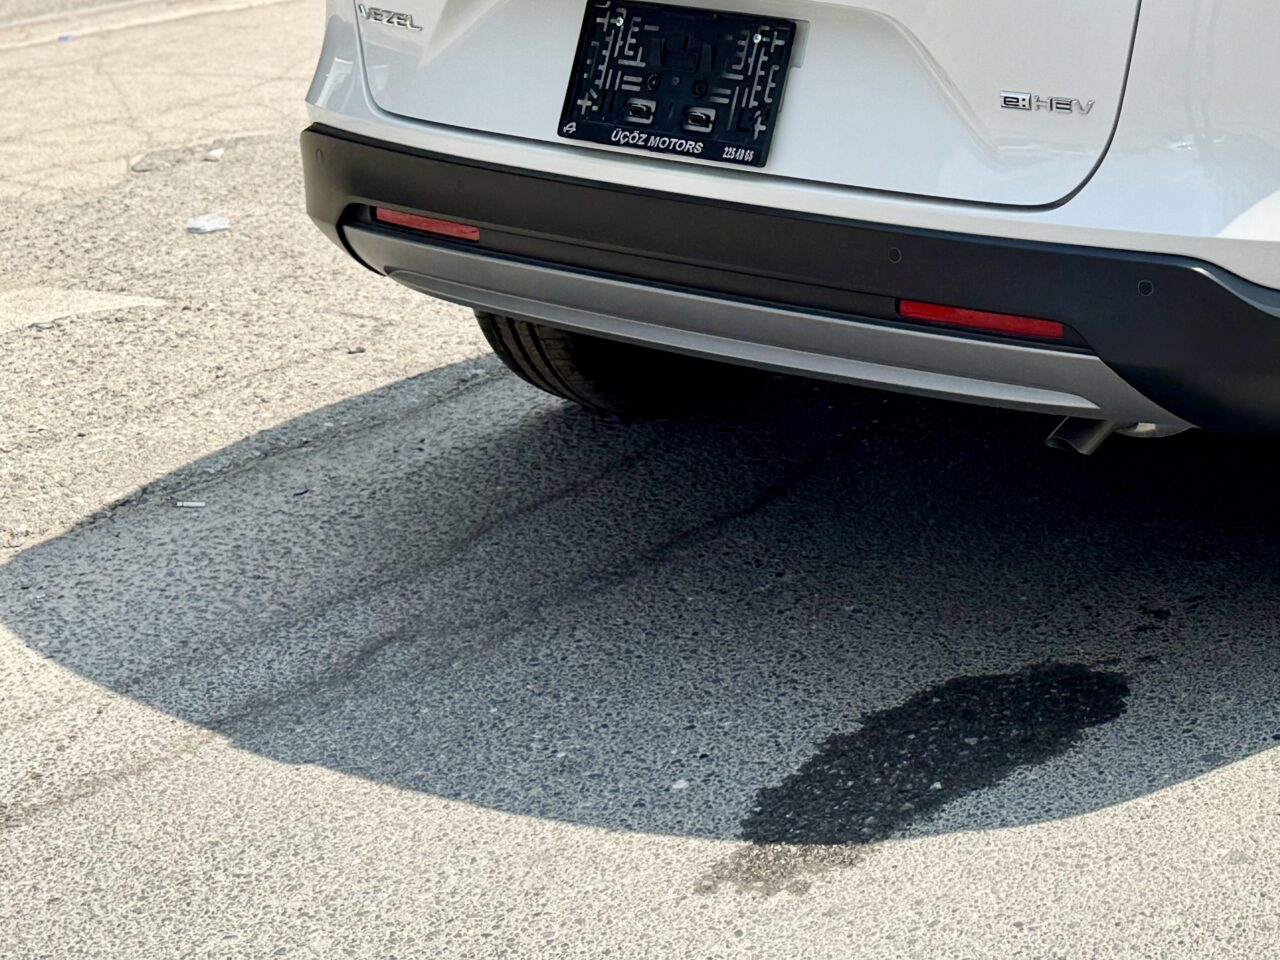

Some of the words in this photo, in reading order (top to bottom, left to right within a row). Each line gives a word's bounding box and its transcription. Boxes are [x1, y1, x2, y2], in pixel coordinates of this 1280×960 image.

[358, 3, 423, 32] VEZEL
[611, 128, 647, 144] ÜÇÖZ
[647, 136, 704, 154] MOTORS
